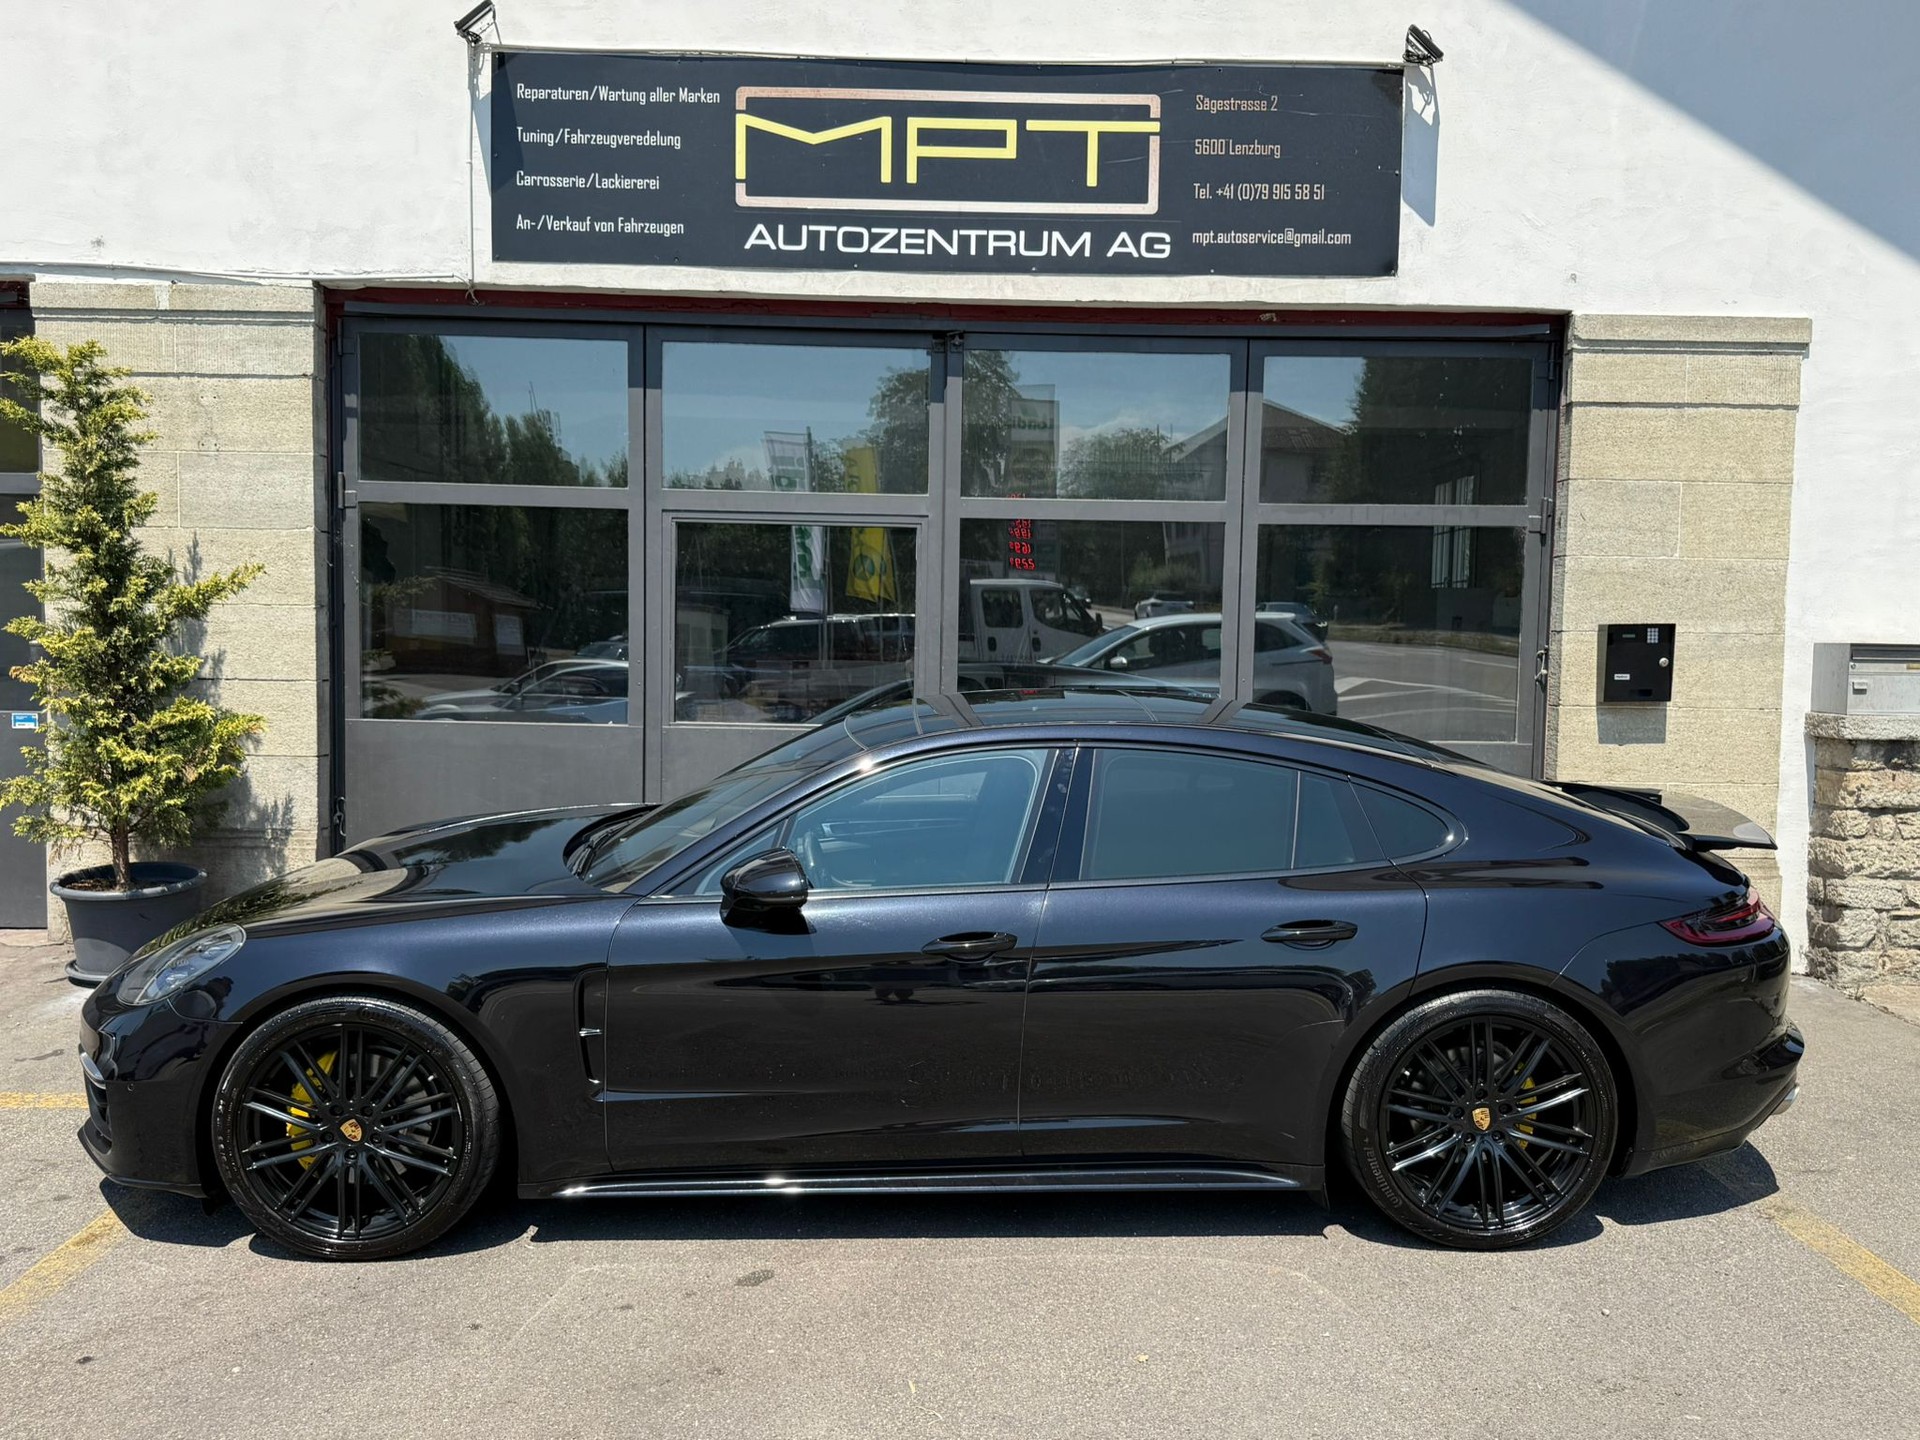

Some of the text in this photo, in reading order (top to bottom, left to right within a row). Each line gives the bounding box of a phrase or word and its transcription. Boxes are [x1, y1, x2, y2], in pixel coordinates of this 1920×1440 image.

[516, 83, 720, 105] Reparaturen/Wartung aller Marken
[1195, 94, 1278, 114] Sägestrasse 2
[516, 127, 682, 150] Tuning/Fahrzeugveredelung
[1194, 138, 1281, 159] 5600 Lenzburg
[736, 113, 1160, 187] MPT
[516, 170, 660, 190] Carrosserie/Lackiererei
[1193, 183, 1325, 202] Tel. +41 (0)79 915 58 51
[516, 214, 684, 236] An-/Verkauf von Fahrzeugen
[744, 223, 1172, 259] AUTOZENTRUM AG
[1192, 227, 1352, 247] mpt.autoservice@gmail.com
